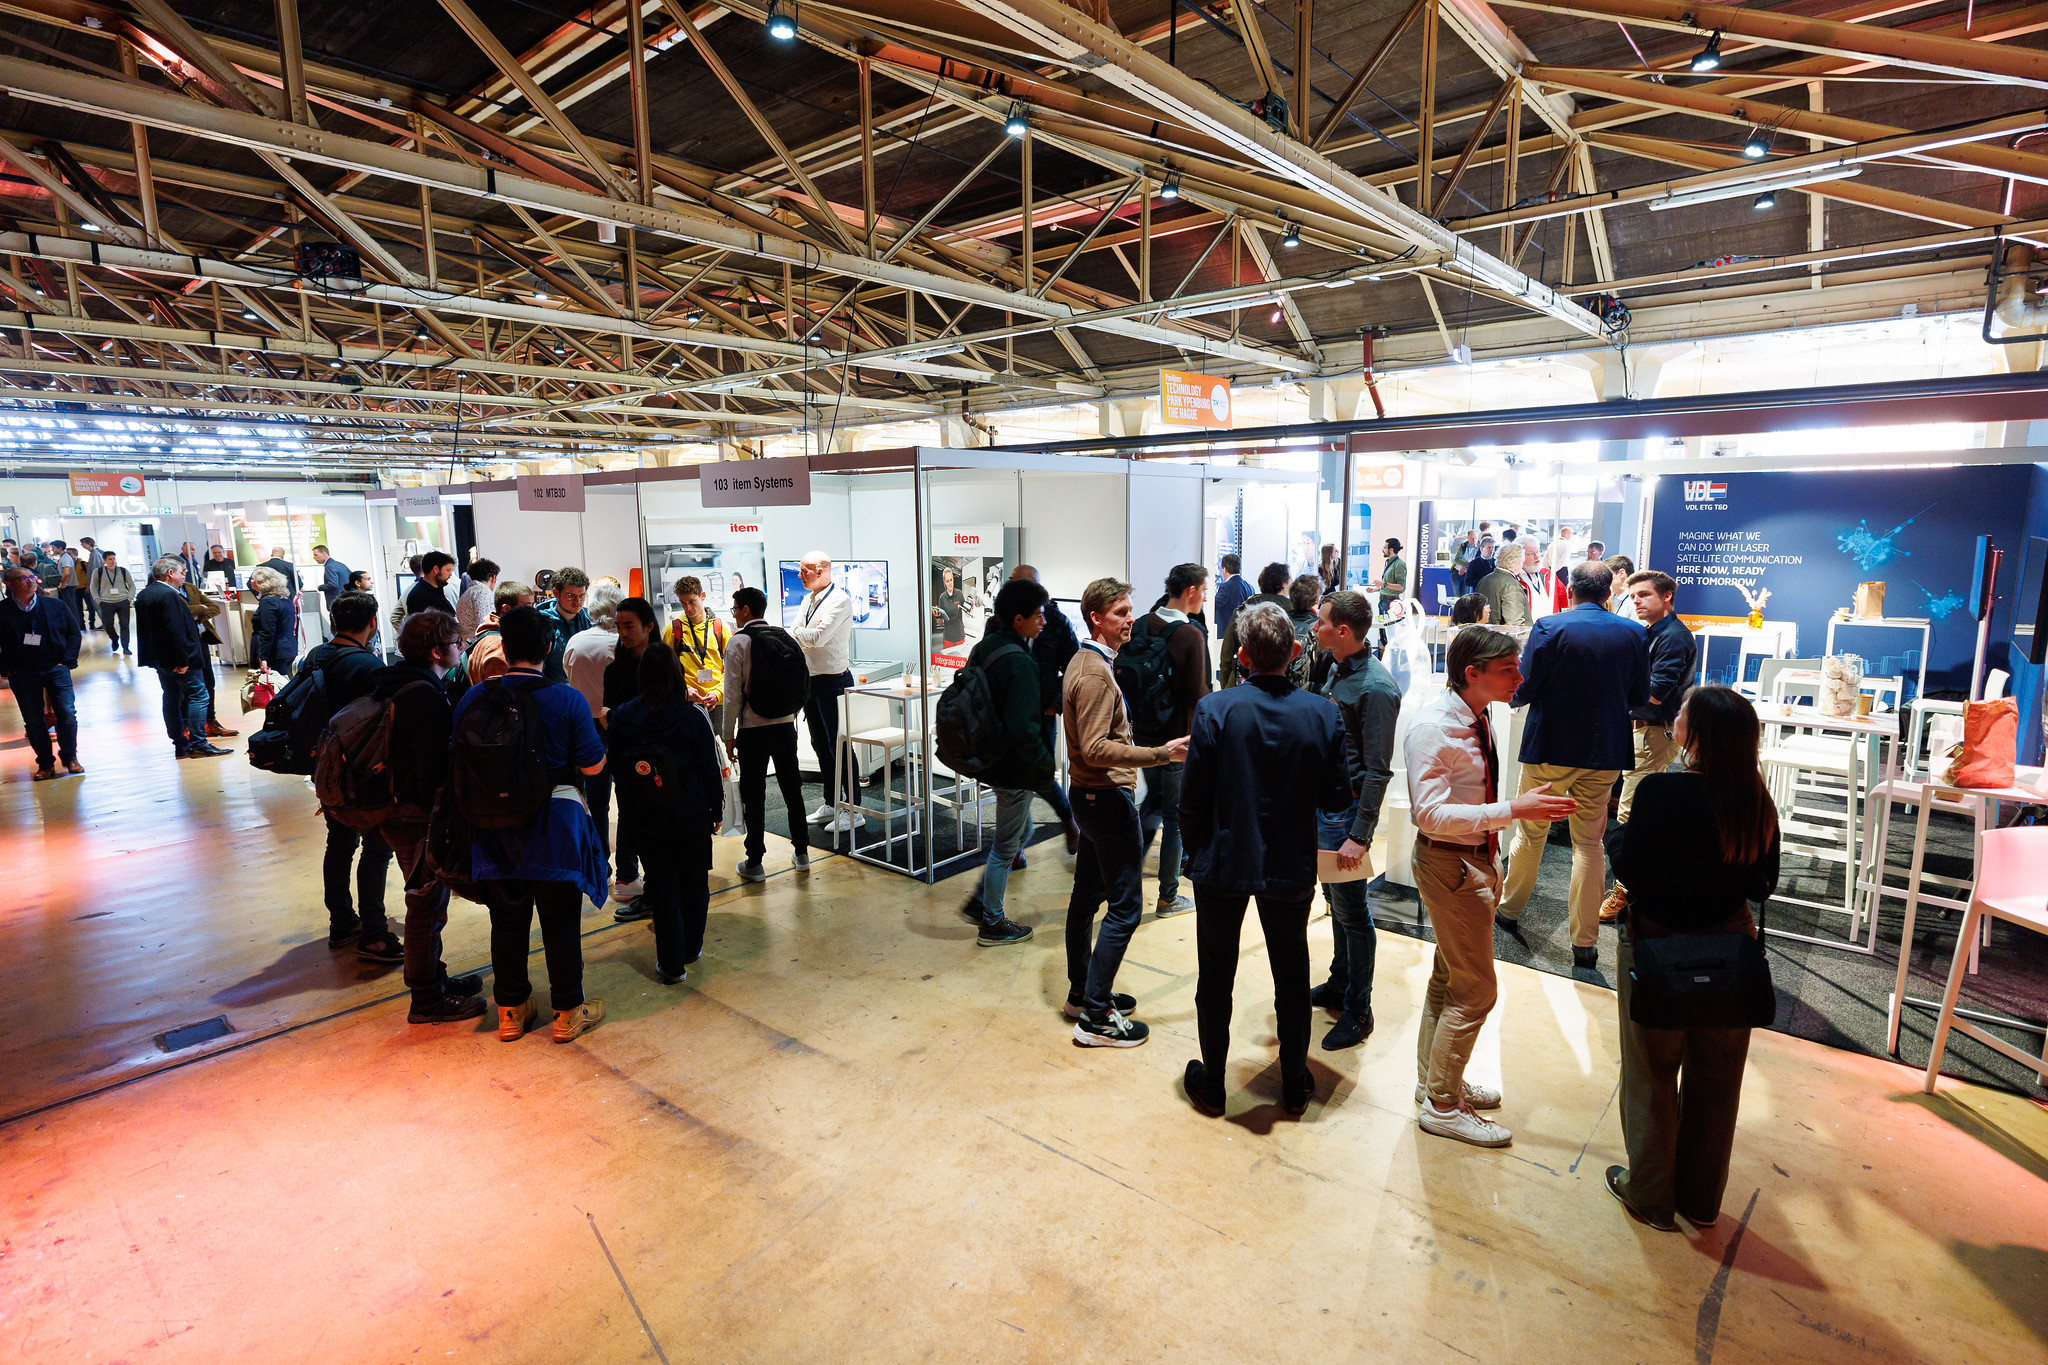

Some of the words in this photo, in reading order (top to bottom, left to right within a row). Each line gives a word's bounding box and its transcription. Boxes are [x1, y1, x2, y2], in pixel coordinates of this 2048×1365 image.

[1166, 382, 1202, 396] TECHNOLOGY
[1166, 394, 1182, 406] PARK
[1183, 396, 1210, 410] YPENBURG
[1168, 406, 1179, 418] THE
[1180, 408, 1198, 420] HAGUE
[714, 478, 728, 490] 103
[732, 478, 752, 490] item
[754, 476, 794, 492] Systems
[534, 488, 544, 498] 102
[546, 487, 566, 498] MTB3D
[1684, 480, 1715, 502] VDL
[730, 523, 758, 532] item
[954, 533, 980, 544] item
[1678, 532, 1714, 540] IMAGINE
[1716, 532, 1744, 540] WHAT
[1746, 532, 1762, 540] WE
[1678, 543, 1696, 552] CAN
[1698, 543, 1712, 552] DO
[1714, 543, 1738, 552] WITH
[1740, 544, 1770, 552] LASER
[1677, 554, 1720, 563] SATELLITE
[1722, 554, 1802, 564] COMMUNICATION
[1676, 566, 1700, 574] HERE
[1702, 566, 1730, 575] NOW,
[1732, 566, 1766, 576] READY
[1676, 576, 1694, 585] FOR
[1696, 577, 1756, 587] TOMORROW
[934, 656, 955, 666] Integrate
